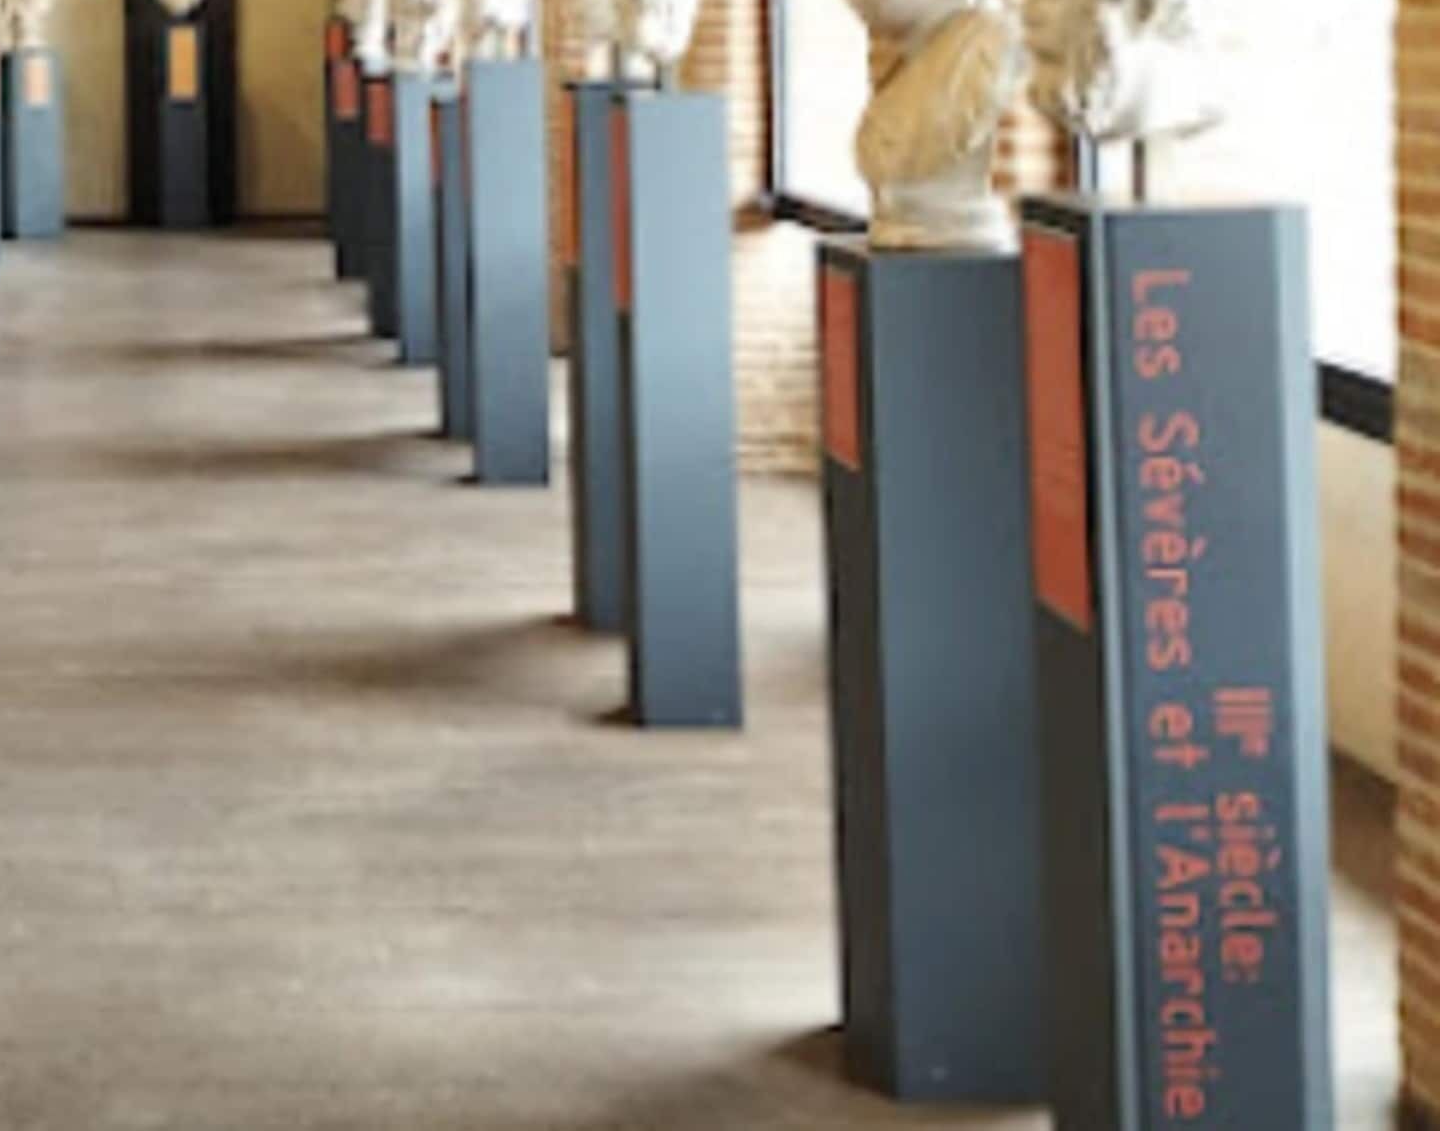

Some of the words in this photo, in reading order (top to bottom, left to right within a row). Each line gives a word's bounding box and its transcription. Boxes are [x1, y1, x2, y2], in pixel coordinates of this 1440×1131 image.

[1131, 270, 1189, 379] Les
[1137, 410, 1207, 671] Sévères
[1148, 702, 1210, 768] et
[1154, 802, 1221, 1119] l'Anarchie
